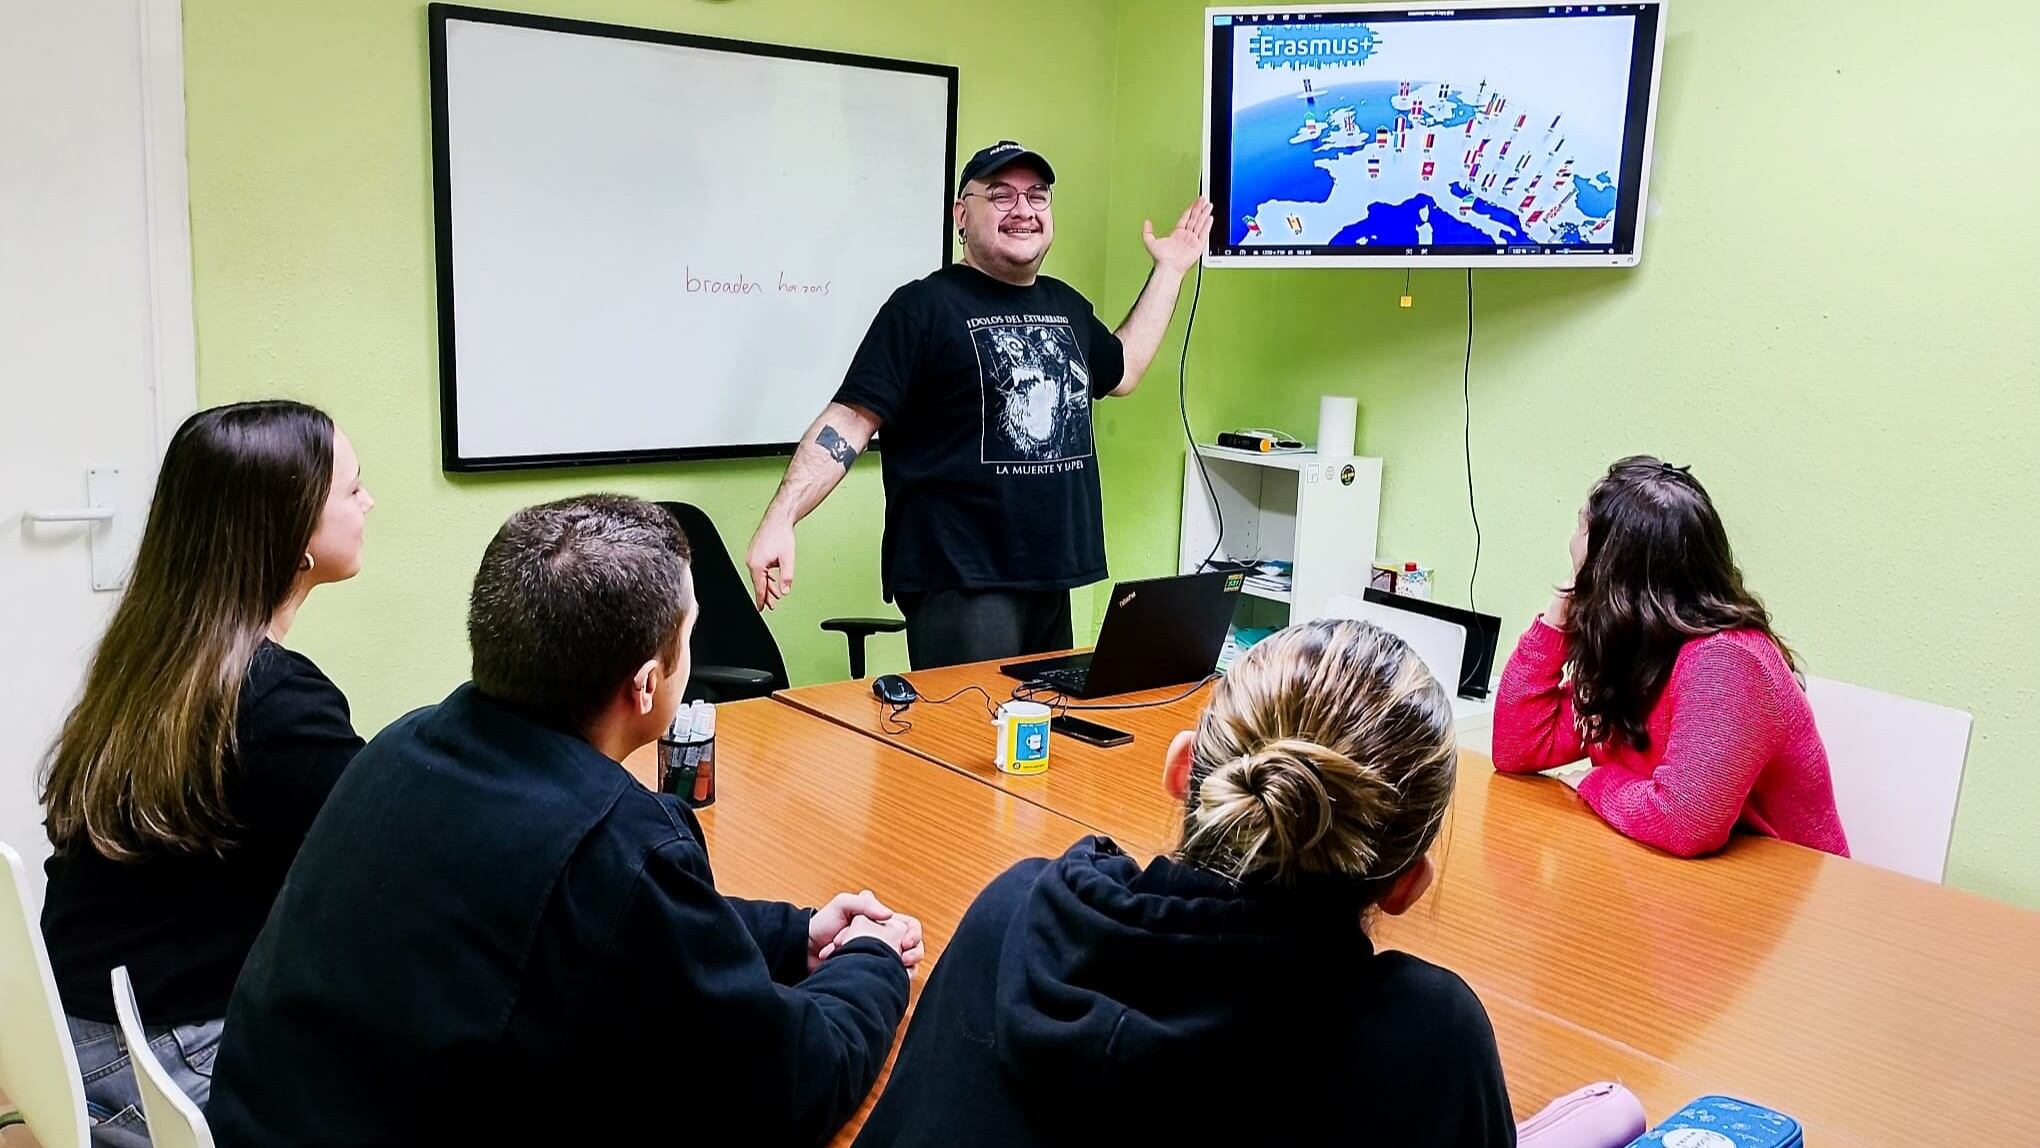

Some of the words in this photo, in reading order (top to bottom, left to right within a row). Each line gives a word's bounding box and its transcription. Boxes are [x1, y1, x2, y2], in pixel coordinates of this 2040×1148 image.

[1260, 36, 1373, 56] Erasmus+
[686, 264, 762, 294] broaden
[966, 315, 1004, 328] IDOLOS
[1004, 314, 1022, 324] DEL
[996, 465, 1009, 475] LA
[1012, 464, 1055, 475] MUERTE
[1056, 463, 1063, 473] Y
